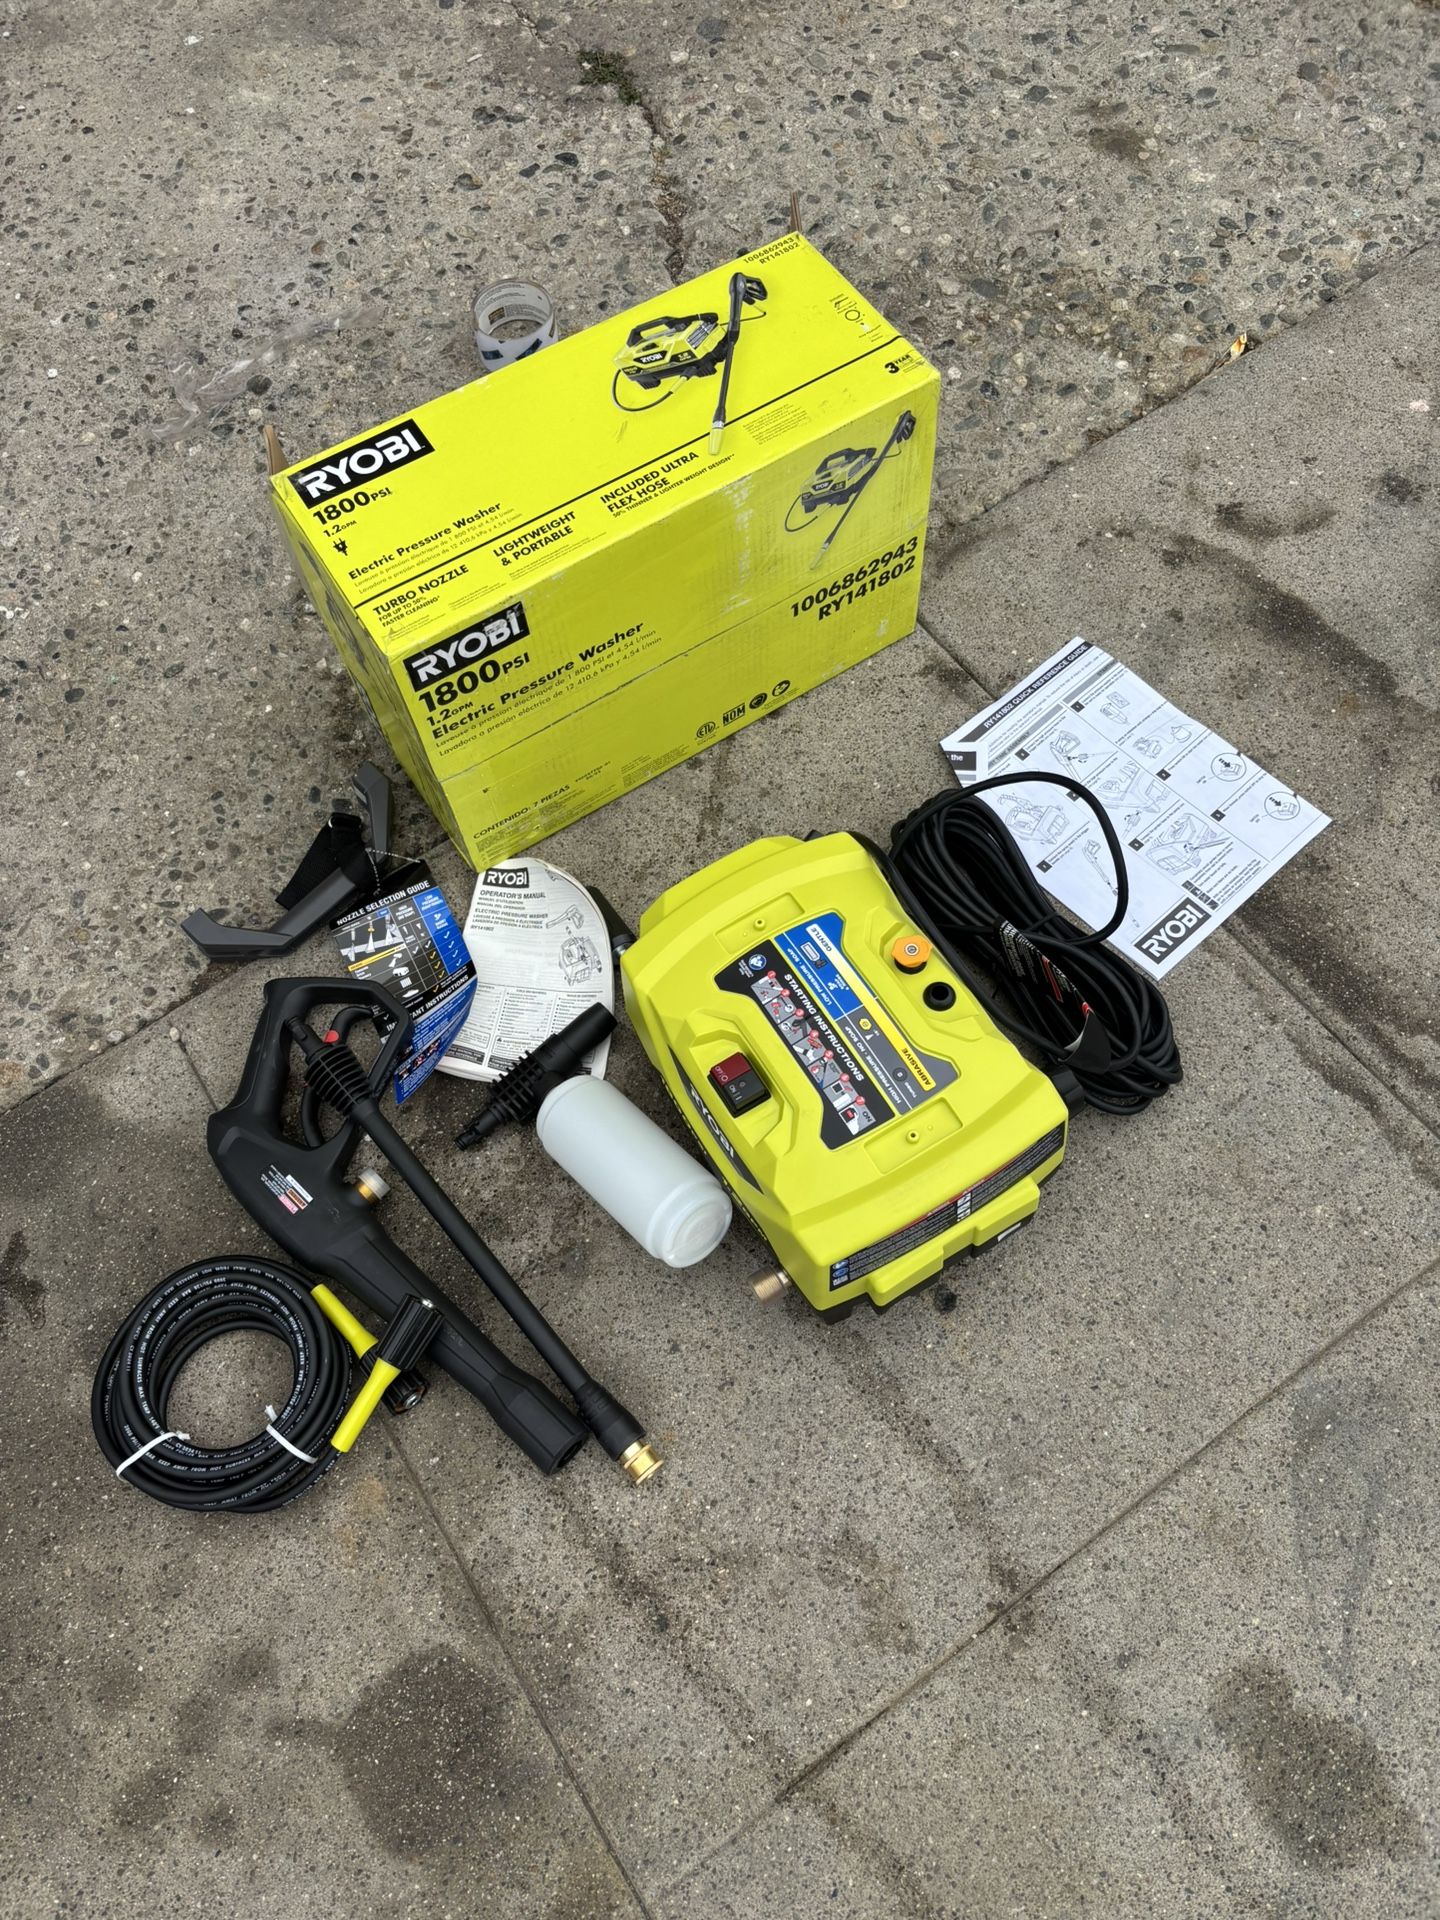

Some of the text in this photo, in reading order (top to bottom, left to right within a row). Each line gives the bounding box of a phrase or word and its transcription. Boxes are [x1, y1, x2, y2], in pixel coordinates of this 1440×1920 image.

[743, 237, 795, 265] 1006862943
[759, 242, 801, 266] RY141802
[884, 361, 899, 375] 3
[299, 429, 423, 499] RYOBI
[600, 451, 699, 504] INCLUDED ULTRA
[607, 477, 670, 514] FLEX HOSE
[627, 495, 653, 514] THINNER
[660, 479, 685, 496] LIGHTER
[685, 468, 707, 484] WEIGHT
[349, 503, 502, 580] Electric Pressure Washer
[493, 511, 576, 558] LIGHTWEIGHT
[501, 524, 574, 568] & PORTABLE
[373, 590, 417, 616] TURBO
[418, 564, 469, 594] NOZZLE
[790, 535, 918, 618] 1006862943
[818, 555, 918, 620] RY141802
[378, 611, 392, 622] FOR
[391, 606, 402, 615] UP
[402, 601, 412, 609] TO
[381, 612, 405, 627] FASTER
[411, 612, 523, 683] RYOBI
[433, 621, 645, 740] Electric Pressure Washer
[1011, 685, 1035, 705] QUICK
[1030, 658, 1069, 689] REFERENCE
[1066, 643, 1088, 662] GUIDE
[478, 707, 513, 729] pression
[574, 665, 590, 678] 800
[592, 658, 606, 671] PSI
[439, 737, 478, 758] Lavadora
[600, 661, 615, 676] kPa
[722, 704, 746, 725] NOM
[473, 807, 531, 840] CONTENIDO:
[540, 784, 571, 803] PIEZAS
[486, 870, 528, 886] RYOBI
[336, 880, 431, 926] NOZZLE SELECTION GUIDE
[480, 889, 523, 900] OPERATOR'S
[811, 927, 832, 953] GENTLE
[1142, 904, 1206, 959] RYOBI
[425, 975, 469, 1009] INSTRUCTIONS
[787, 948, 832, 1006] LOW PRESSURE SOAP
[784, 974, 864, 1081] STARTING INSTRUCTIONS
[845, 1026, 858, 1042] SOAP
[865, 1055, 892, 1090] PRESSURE
[902, 1047, 932, 1085] ABRASIVE
[690, 1083, 734, 1158] RYOBI
[863, 1110, 874, 1123] ON
[175, 1271, 198, 1287] SURFACES
[180, 1287, 191, 1297] BAR
[166, 1296, 179, 1308] KEEP
[258, 1287, 281, 1305] SURFACES
[279, 1303, 290, 1315] HOT
[144, 1323, 155, 1339] FROM
[153, 1308, 167, 1323] AWAY
[289, 1317, 299, 1331] FROM
[139, 1341, 148, 1353] HOT
[294, 1331, 304, 1348] AWAY
[137, 1386, 145, 1398] MAX
[141, 1400, 151, 1415] TEMP
[157, 1457, 171, 1467] KEEP
[171, 1463, 188, 1471] AWAY
